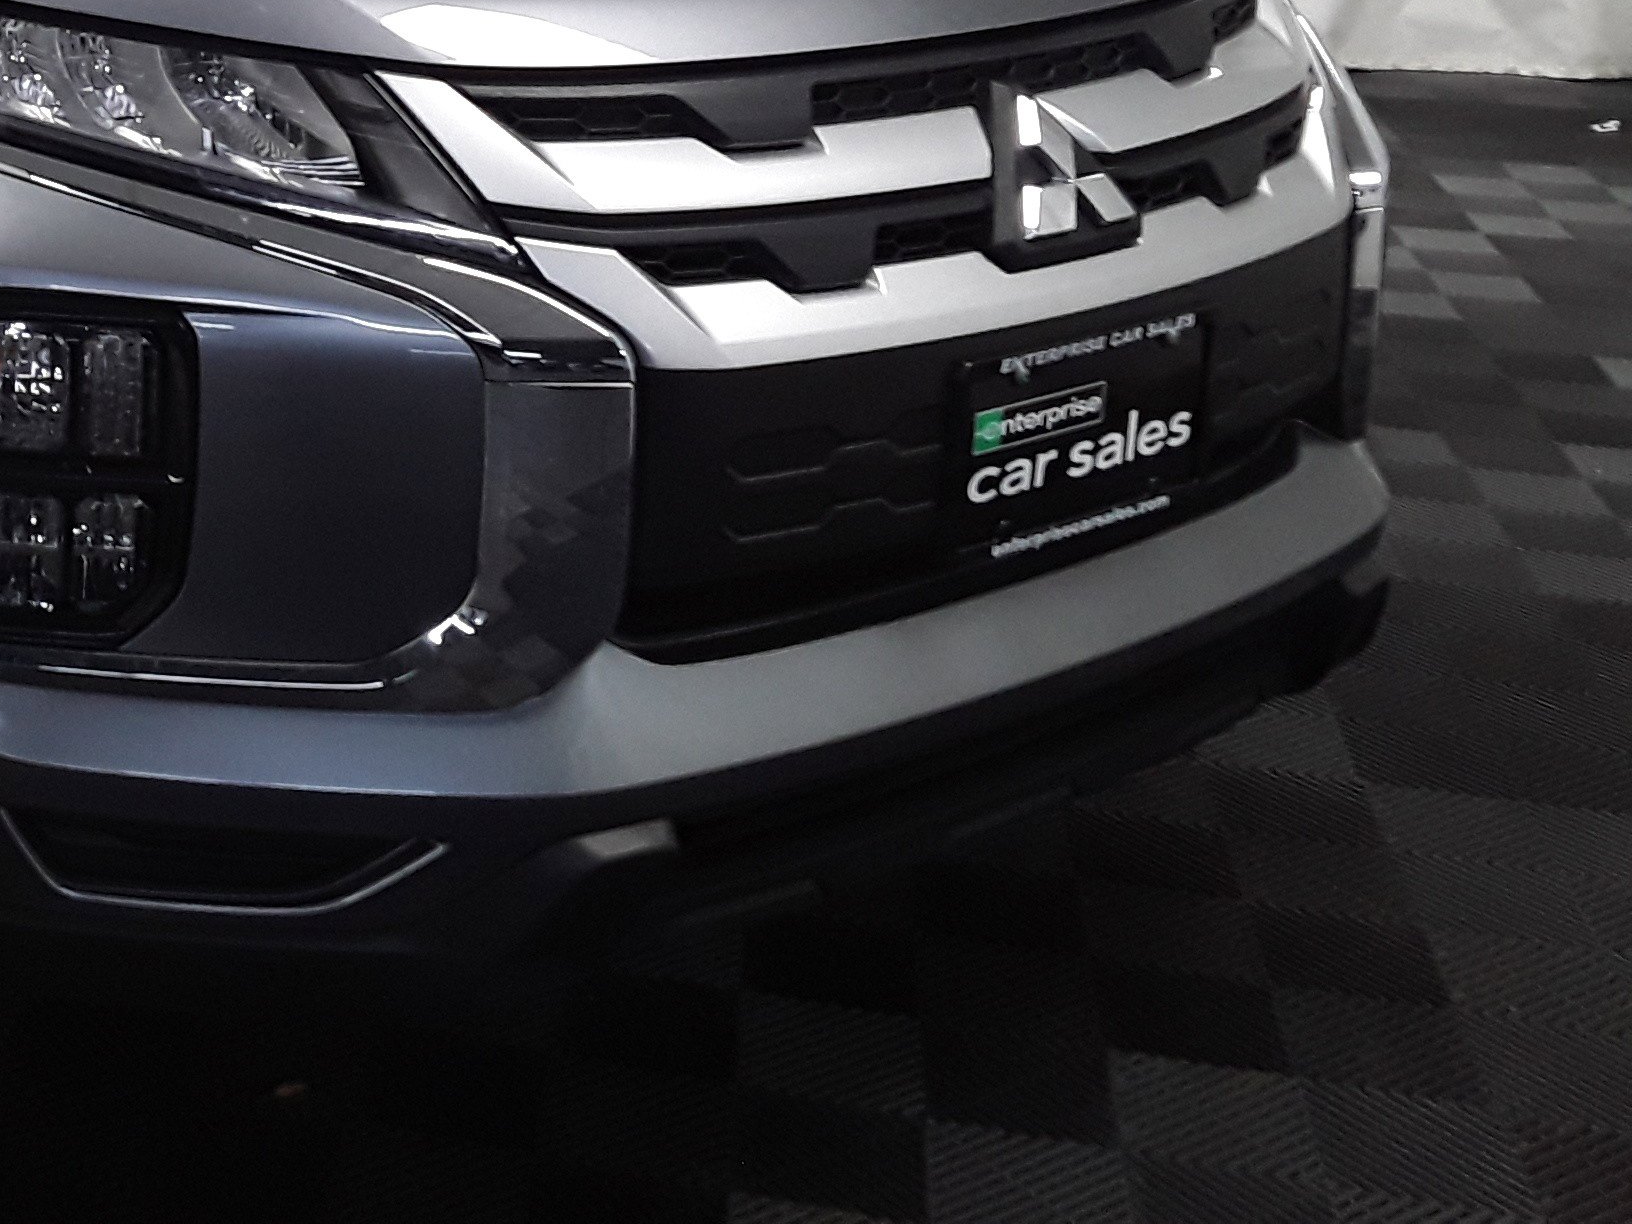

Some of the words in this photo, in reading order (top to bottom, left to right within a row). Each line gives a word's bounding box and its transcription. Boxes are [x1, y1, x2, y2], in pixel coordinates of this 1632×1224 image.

[976, 395, 1104, 440] enterprise
[967, 449, 1059, 503] car
[1066, 409, 1193, 478] sales
